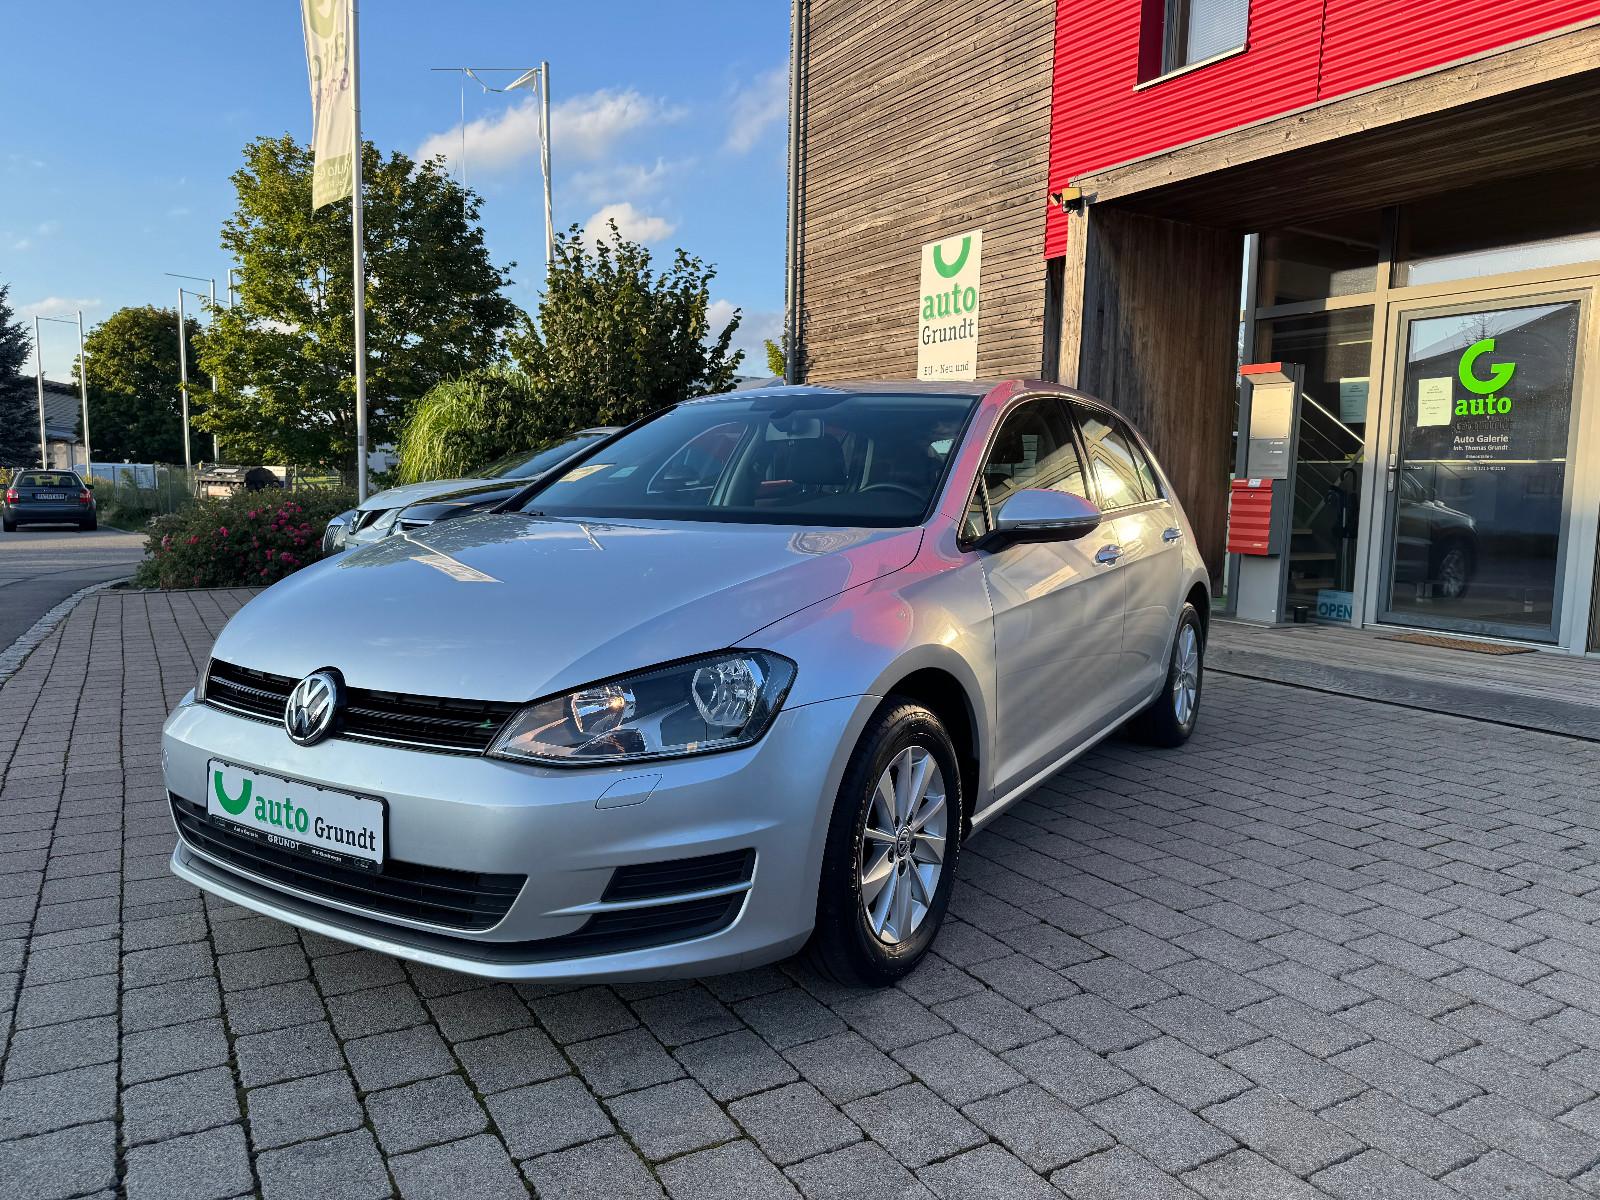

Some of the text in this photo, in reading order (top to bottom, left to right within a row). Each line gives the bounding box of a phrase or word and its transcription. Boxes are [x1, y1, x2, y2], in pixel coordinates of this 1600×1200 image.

[922, 282, 977, 321] auto
[922, 317, 975, 346] Grundt
[955, 360, 969, 372] und
[1454, 394, 1512, 416] auto
[1453, 434, 1509, 444] Auto Galerie
[1318, 602, 1353, 619] OPEN
[254, 795, 377, 852] auto Grundt
[267, 834, 301, 851] GRUNDT
